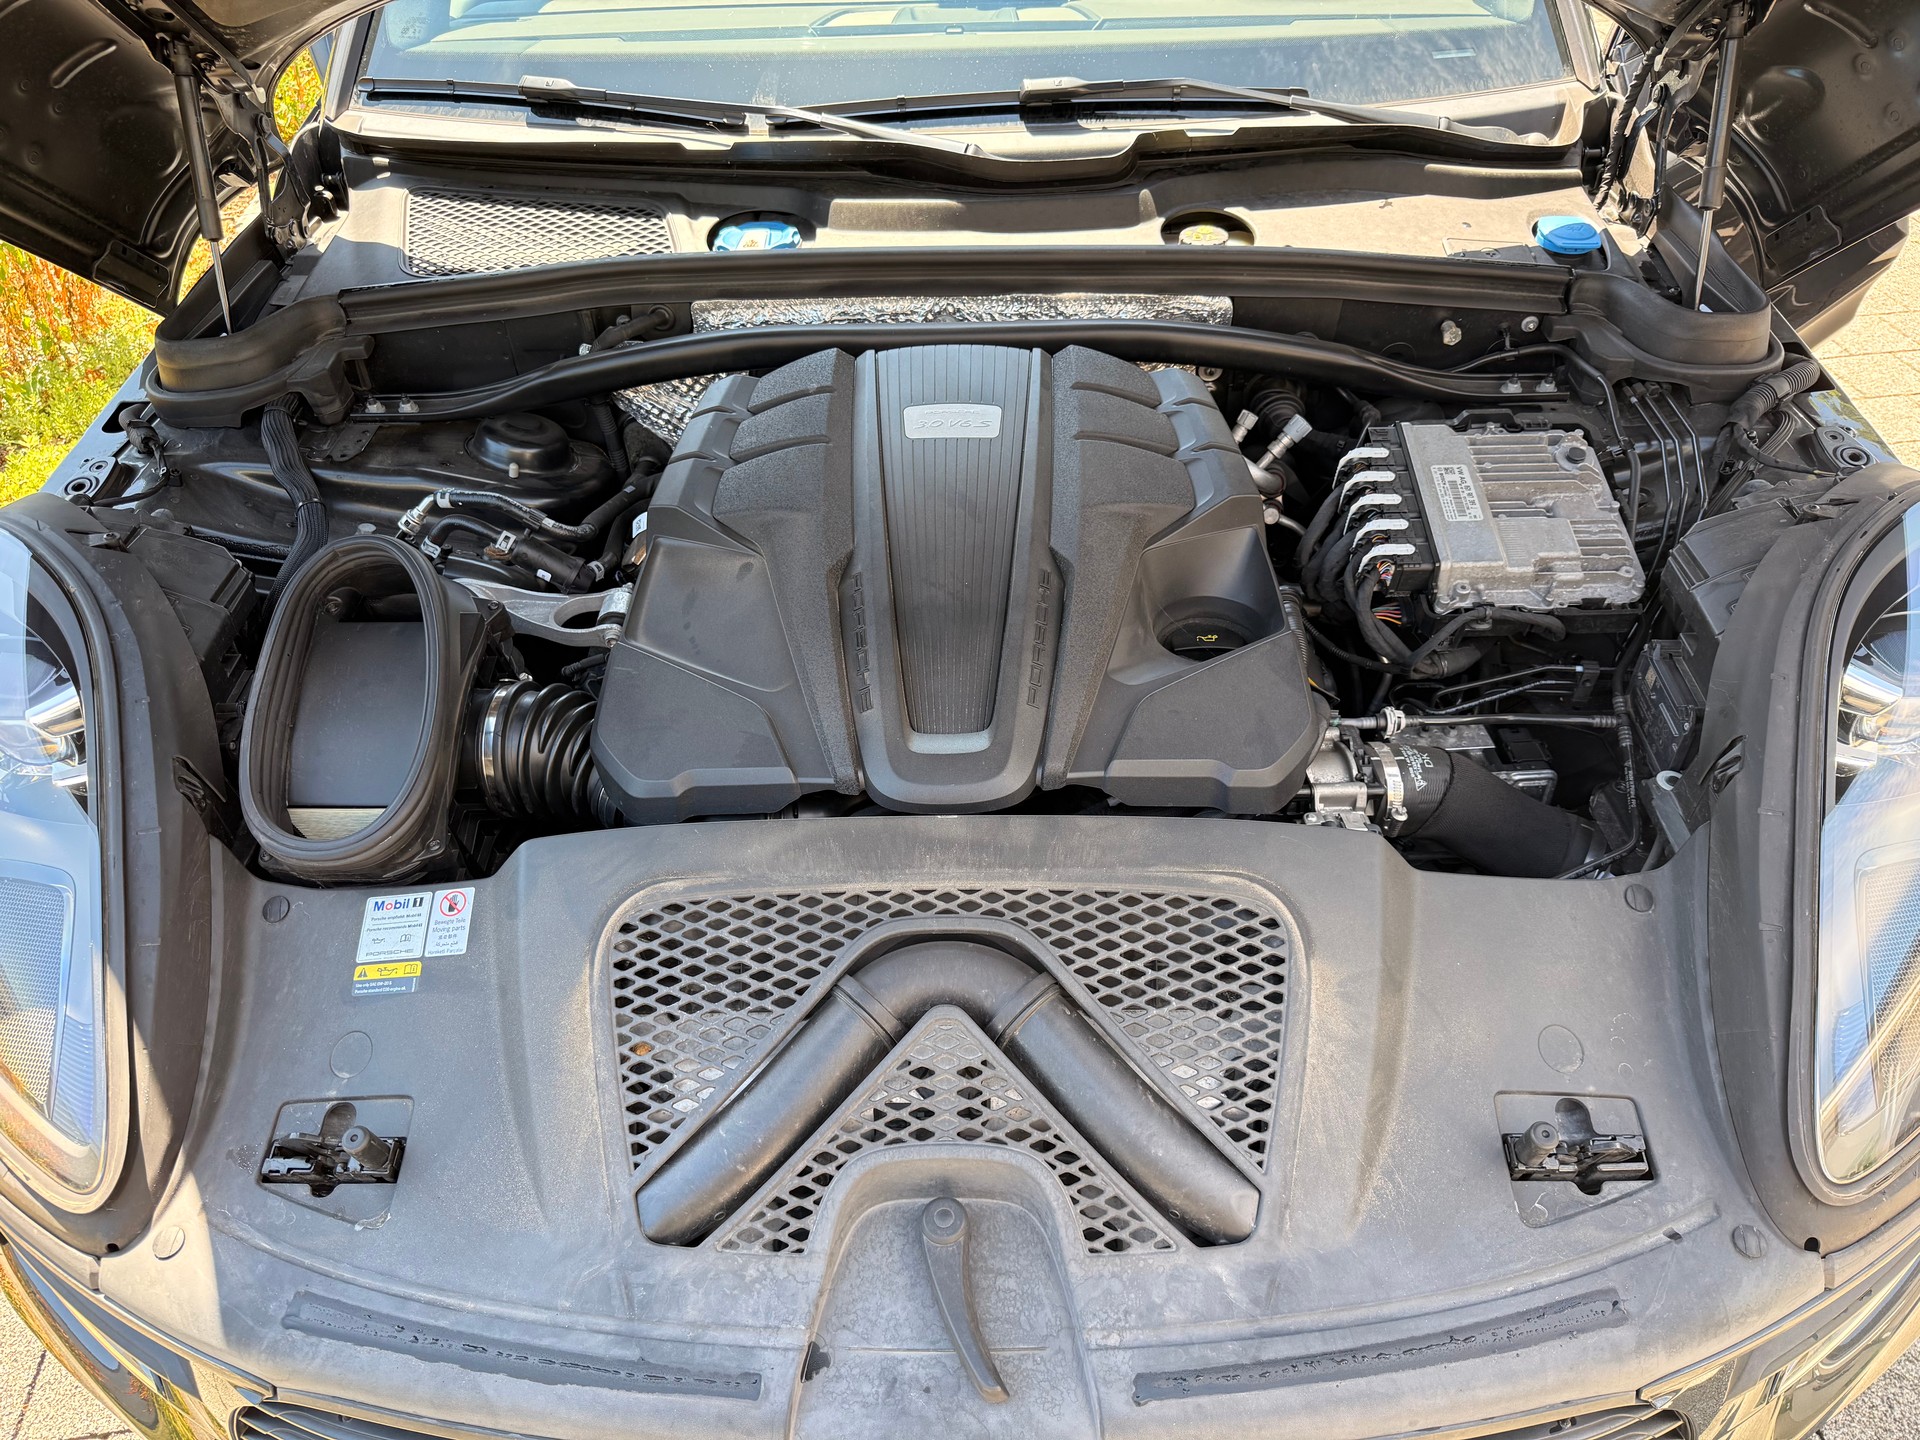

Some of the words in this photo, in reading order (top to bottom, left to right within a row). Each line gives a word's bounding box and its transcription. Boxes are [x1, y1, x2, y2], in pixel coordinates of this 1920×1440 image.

[949, 419, 972, 428] V6
[973, 419, 992, 428] S
[1456, 466, 1464, 476] VW
[1459, 476, 1467, 484] AG
[850, 571, 873, 714] PORSCHE
[1026, 568, 1052, 710] PORSCHE
[373, 898, 410, 912] Mobil
[413, 897, 423, 907] 1
[365, 948, 414, 957] PORSCHE
